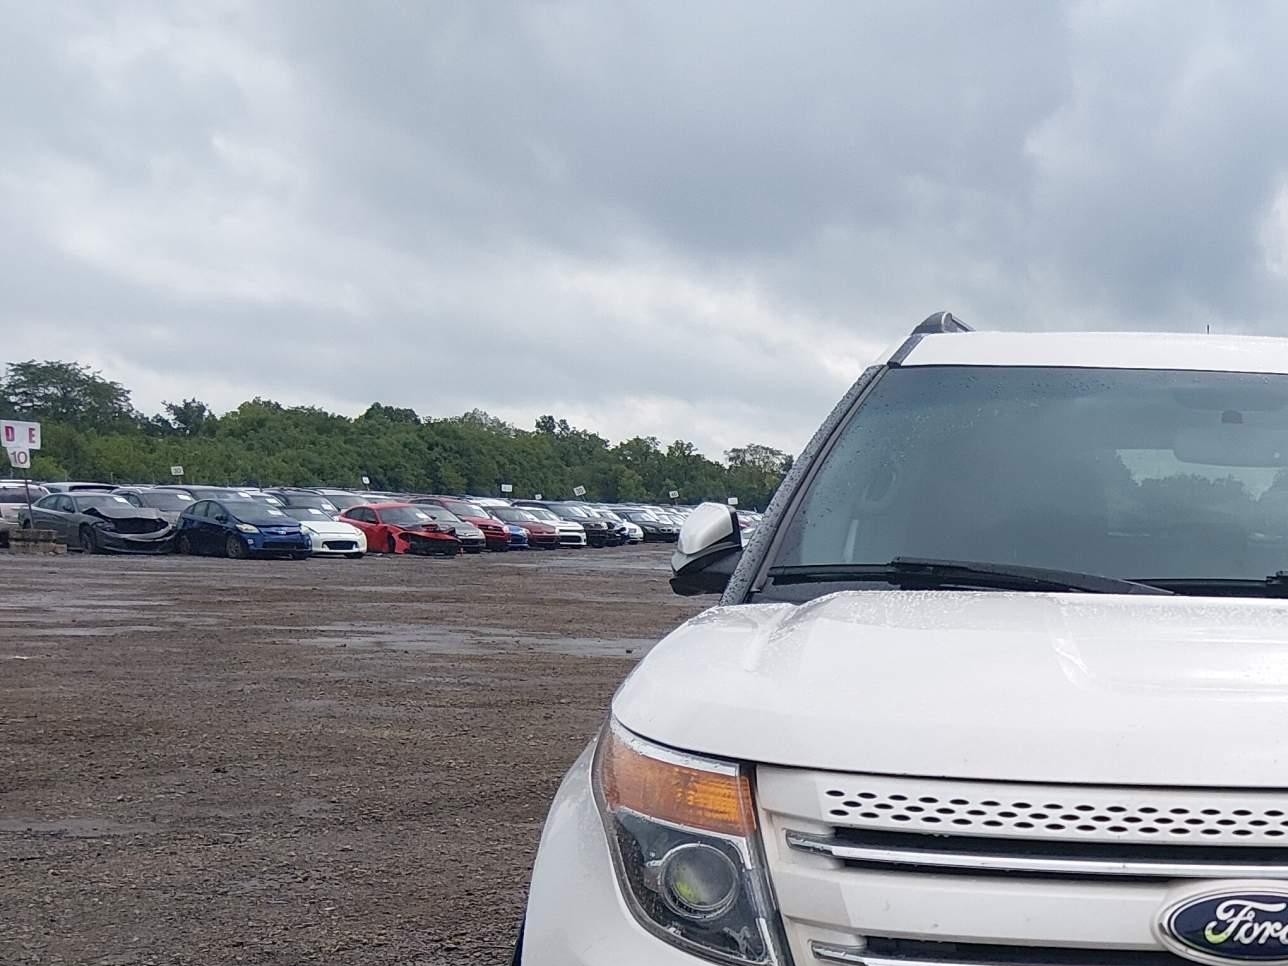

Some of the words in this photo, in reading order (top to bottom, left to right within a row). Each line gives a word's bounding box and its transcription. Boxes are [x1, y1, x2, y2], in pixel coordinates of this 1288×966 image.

[5, 425, 15, 442] D
[28, 427, 36, 443] E
[10, 451, 28, 465] 10
